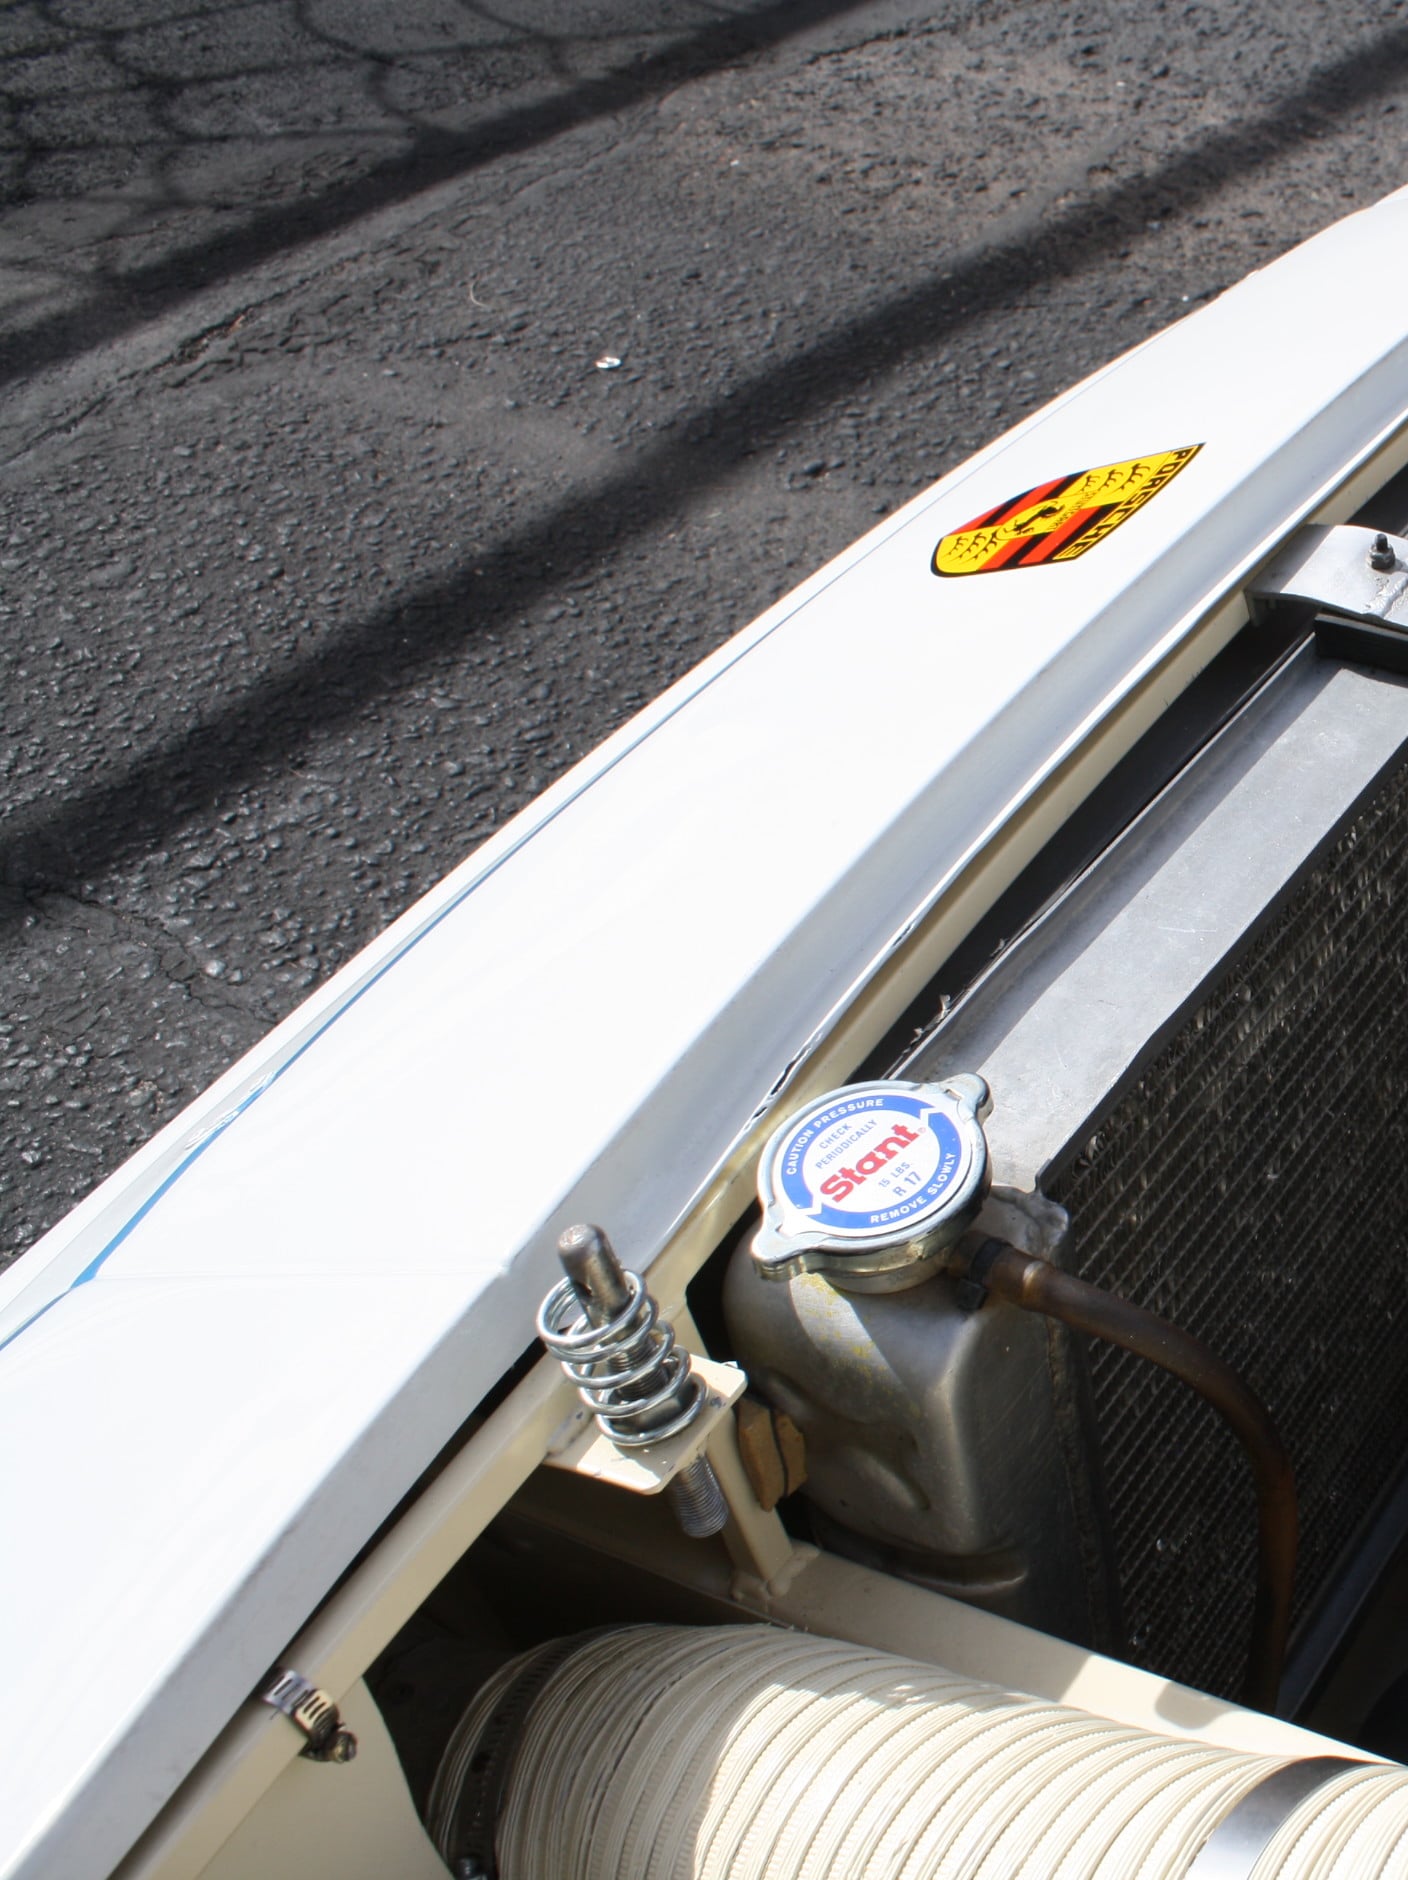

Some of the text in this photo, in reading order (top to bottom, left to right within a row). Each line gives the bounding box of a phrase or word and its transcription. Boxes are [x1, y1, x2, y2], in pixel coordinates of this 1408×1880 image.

[1055, 449, 1196, 560] PORSCHE
[786, 1097, 885, 1176] CAUTION PRESSURE
[815, 1118, 878, 1170] PERIODICALLY
[819, 1122, 853, 1150] CHECK
[819, 1123, 920, 1204] Stant
[869, 1151, 957, 1225] REMOVE SLOWLY
[877, 1178, 891, 1189] 15
[892, 1171, 922, 1198] R 17
